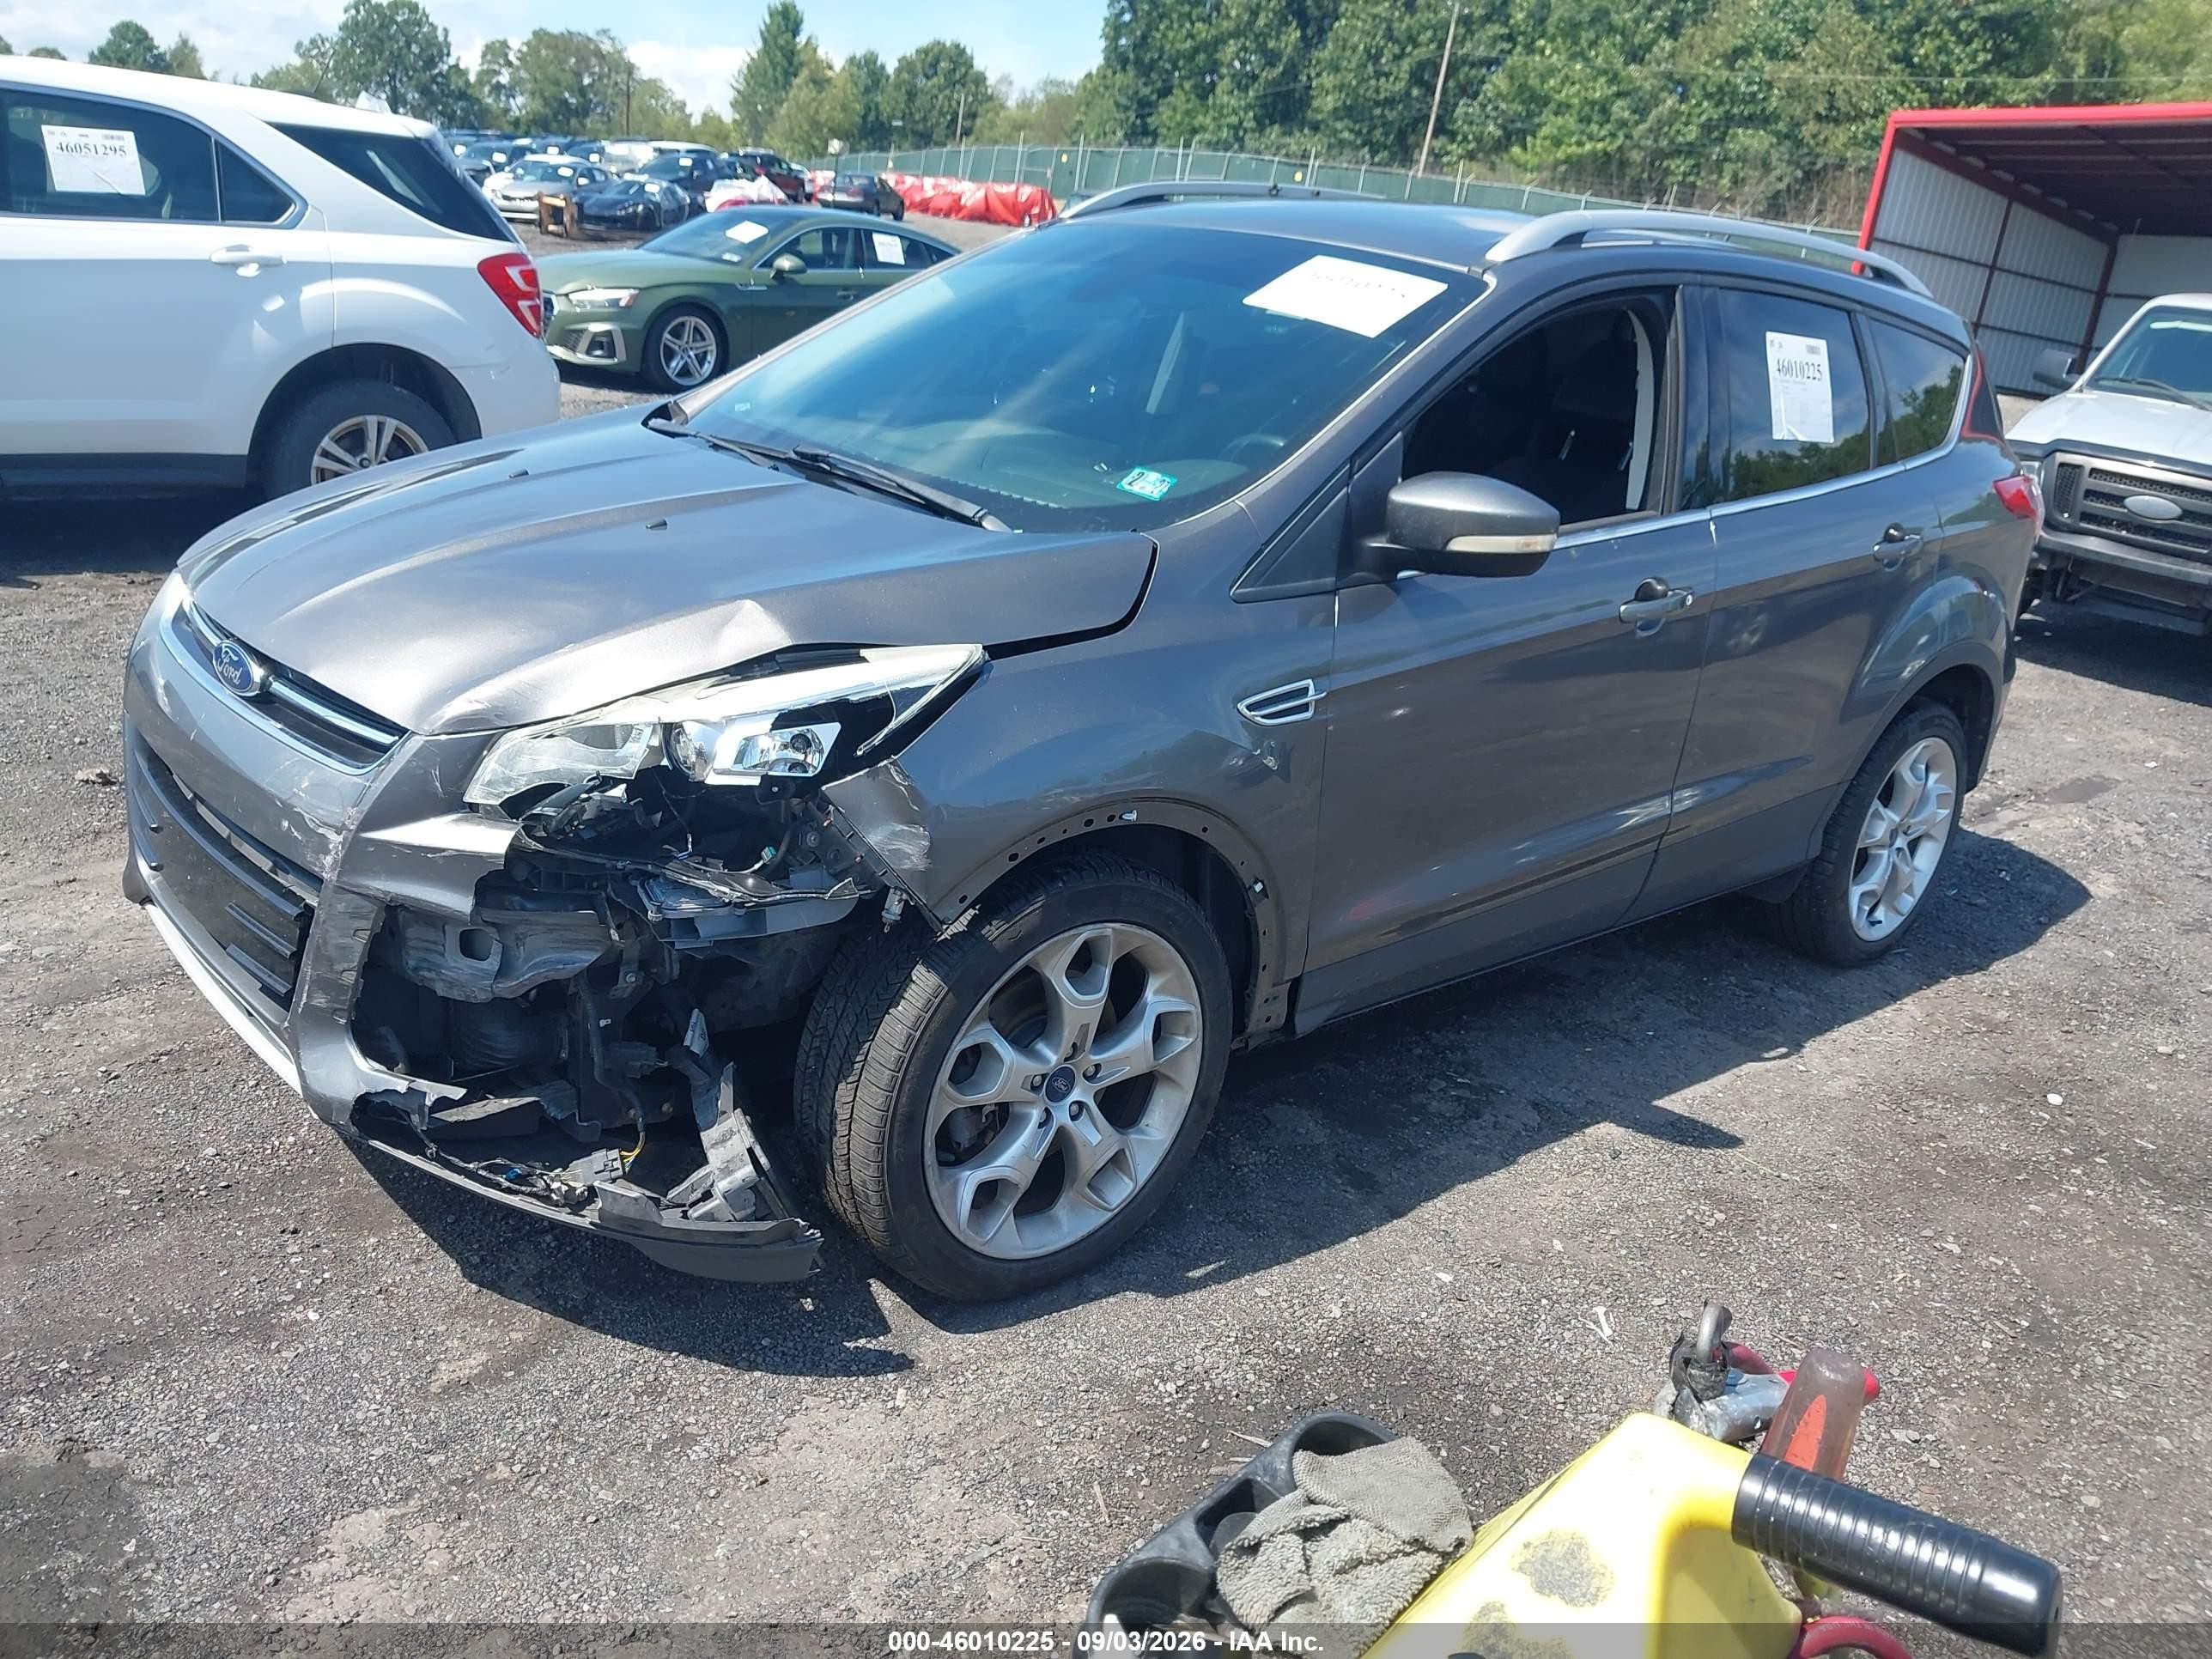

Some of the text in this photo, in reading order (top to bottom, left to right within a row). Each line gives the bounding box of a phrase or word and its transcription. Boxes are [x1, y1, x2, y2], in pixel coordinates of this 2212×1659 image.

[56, 141, 128, 157] 46051295
[1776, 357, 1823, 382] 46010225
[217, 644, 243, 685] Ford
